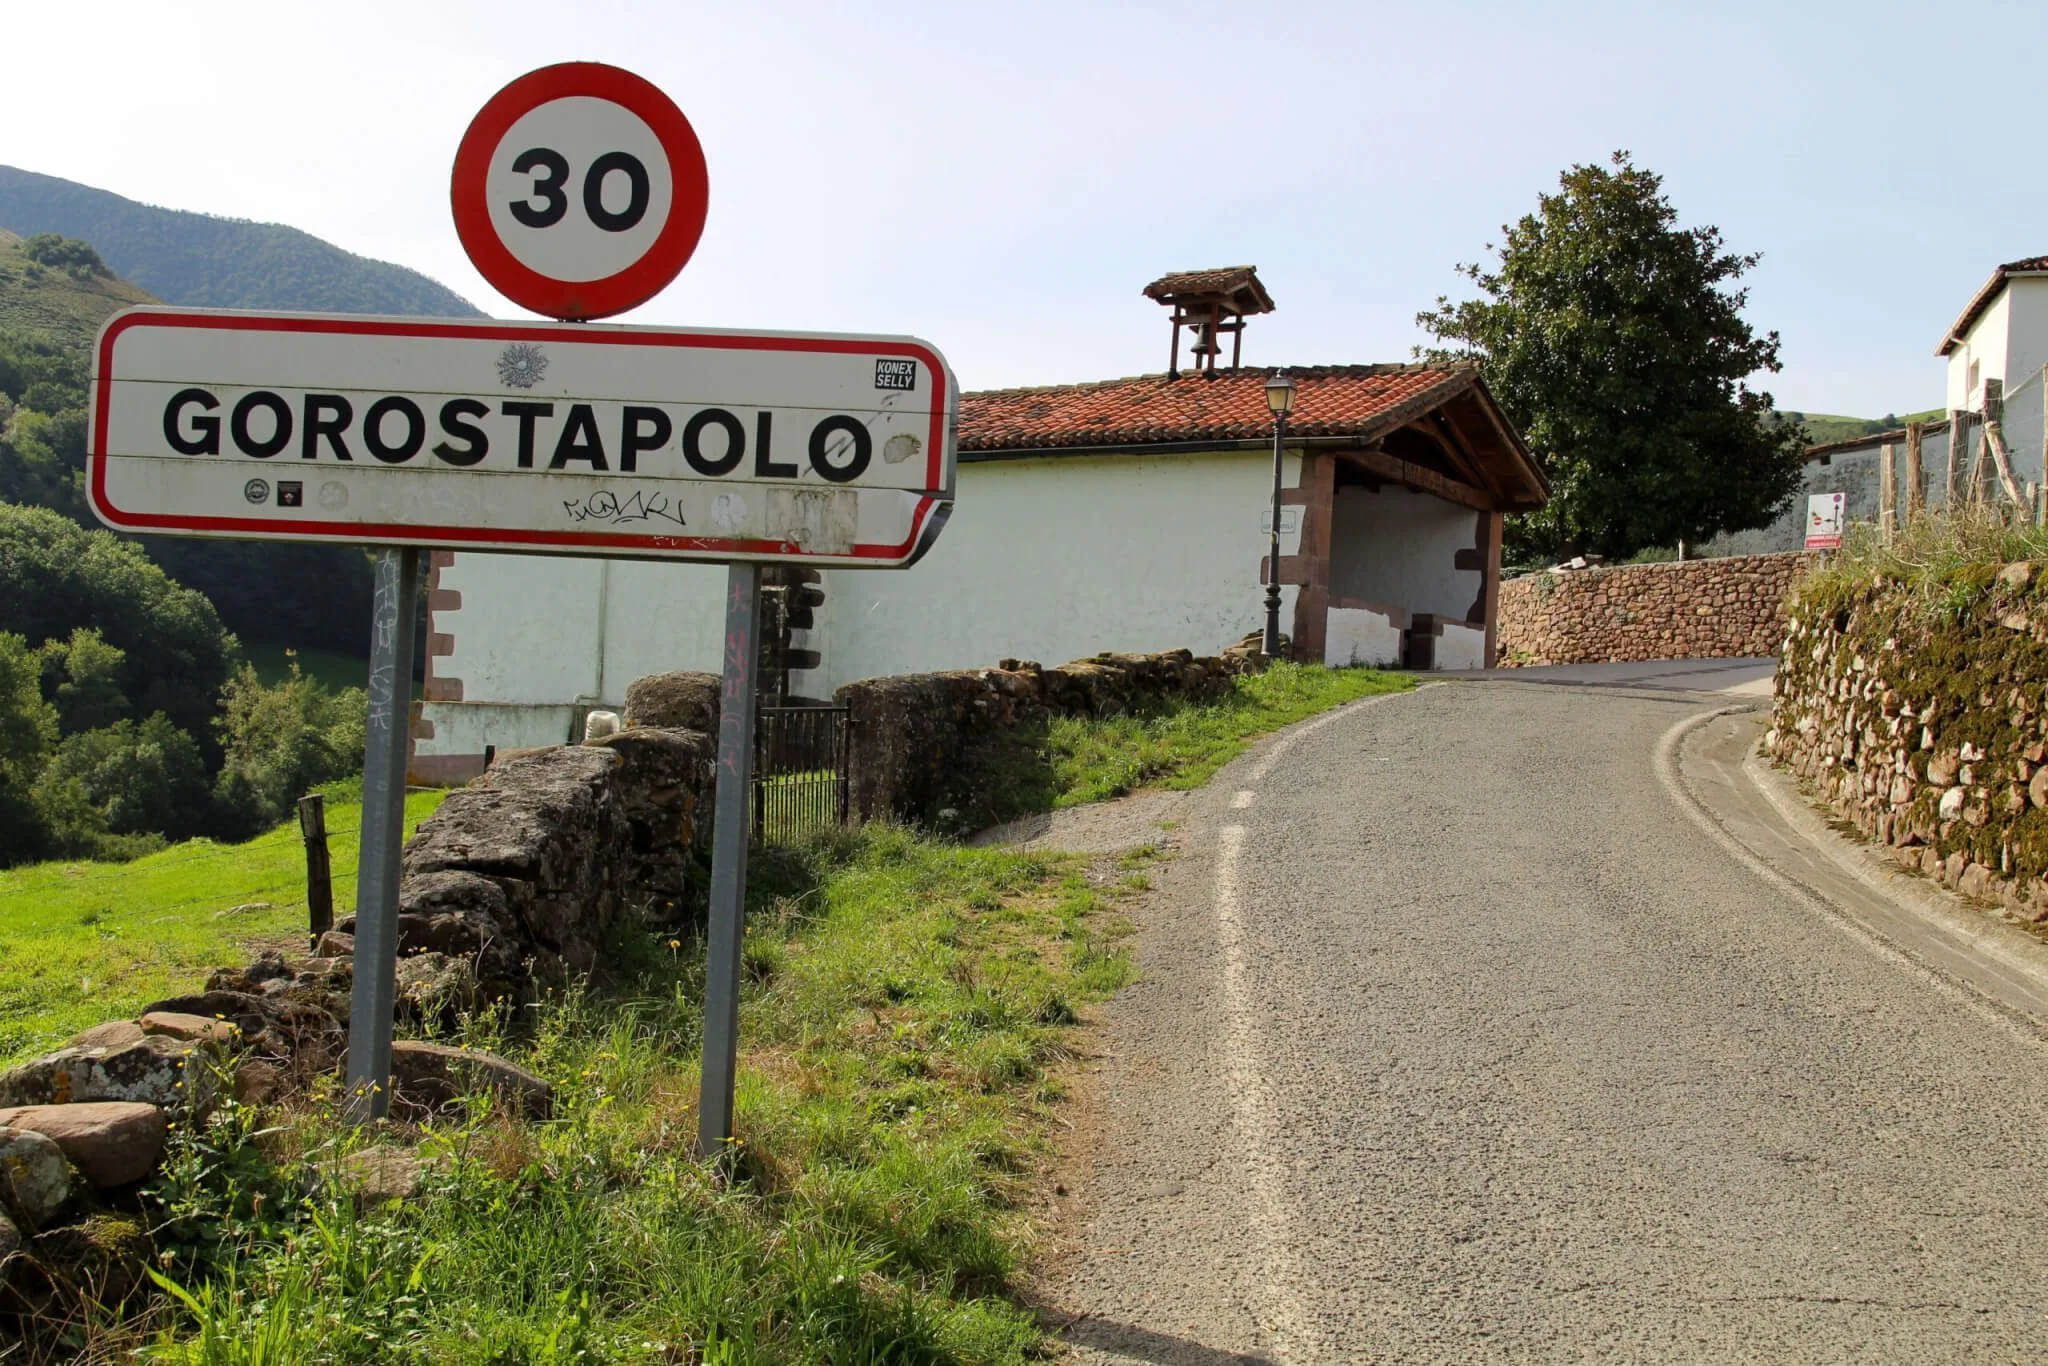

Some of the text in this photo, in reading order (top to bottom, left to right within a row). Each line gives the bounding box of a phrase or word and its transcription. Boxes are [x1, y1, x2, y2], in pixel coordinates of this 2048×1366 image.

[509, 147, 650, 233] 30
[876, 374, 913, 388] SELLY
[877, 361, 913, 375] KONEX
[162, 388, 873, 483] GOROSTAPOLO
